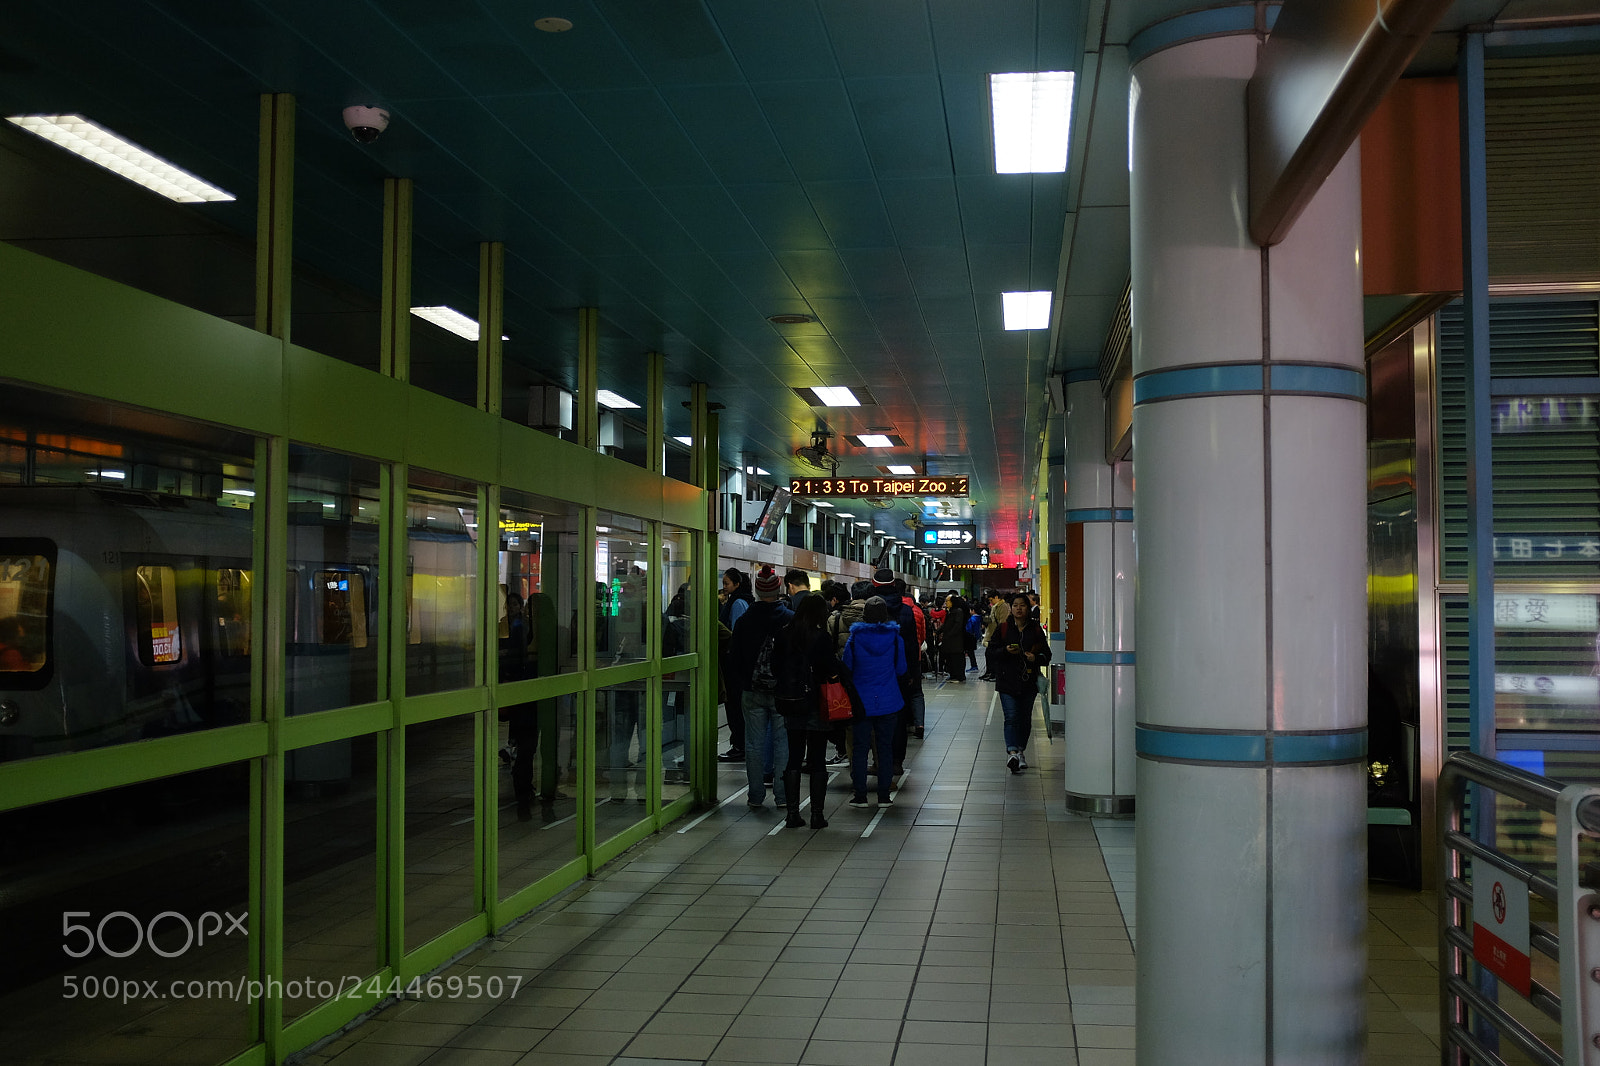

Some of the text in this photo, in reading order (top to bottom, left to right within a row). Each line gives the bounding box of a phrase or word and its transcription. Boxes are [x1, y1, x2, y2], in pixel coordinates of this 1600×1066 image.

[792, 480, 846, 494] 21:33
[849, 480, 869, 493] To
[872, 479, 915, 496] Taipei
[918, 479, 947, 493] Zoo
[103, 551, 121, 564] 121
